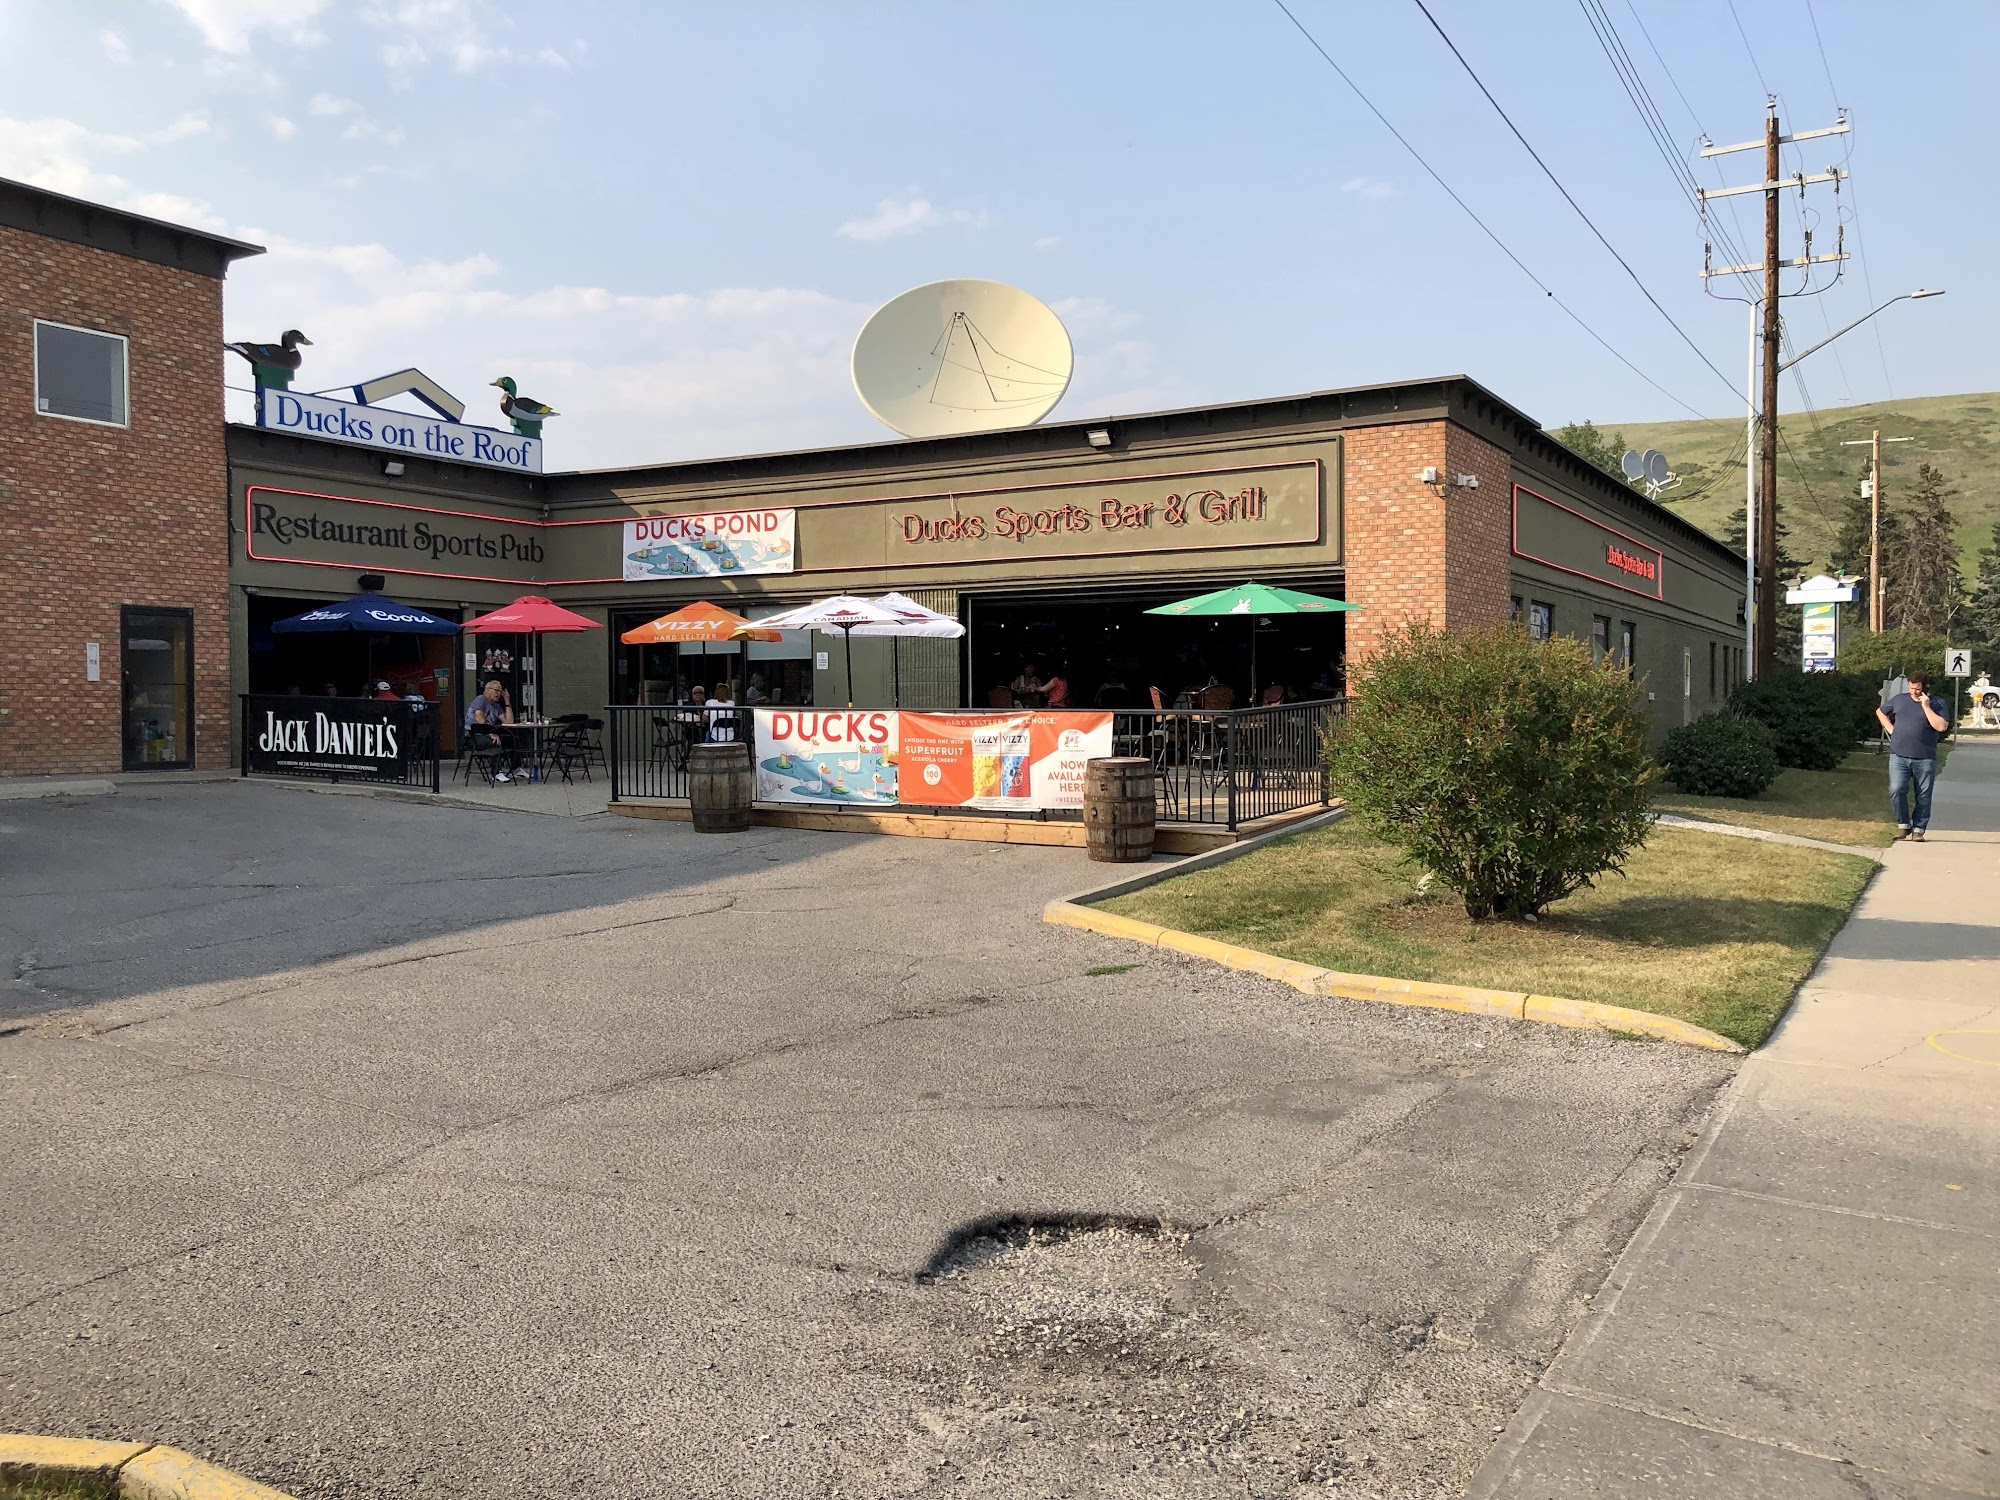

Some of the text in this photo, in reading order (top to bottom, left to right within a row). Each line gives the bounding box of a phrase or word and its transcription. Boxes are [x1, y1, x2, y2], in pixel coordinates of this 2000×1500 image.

[276, 395, 532, 467] Ducks on the Roof
[903, 487, 1266, 543] Ducks Sports Bar & Grill
[635, 512, 778, 541] DUCKS POND
[253, 502, 544, 563] Restaurant Sports Pub
[365, 609, 435, 624] Coors
[653, 620, 725, 631] VIZZY
[1025, 717, 1057, 725] CHOICE.
[772, 712, 889, 743] DUCKS
[259, 711, 399, 759] JACK DANIEL'S
[973, 735, 998, 744] VIZZY
[1003, 735, 1028, 744] VIZZY
[905, 745, 964, 756] SUPERFRUIT
[1060, 760, 1086, 770] NOW
[1048, 771, 1087, 781] AVAILA
[1059, 782, 1085, 792] HERE
